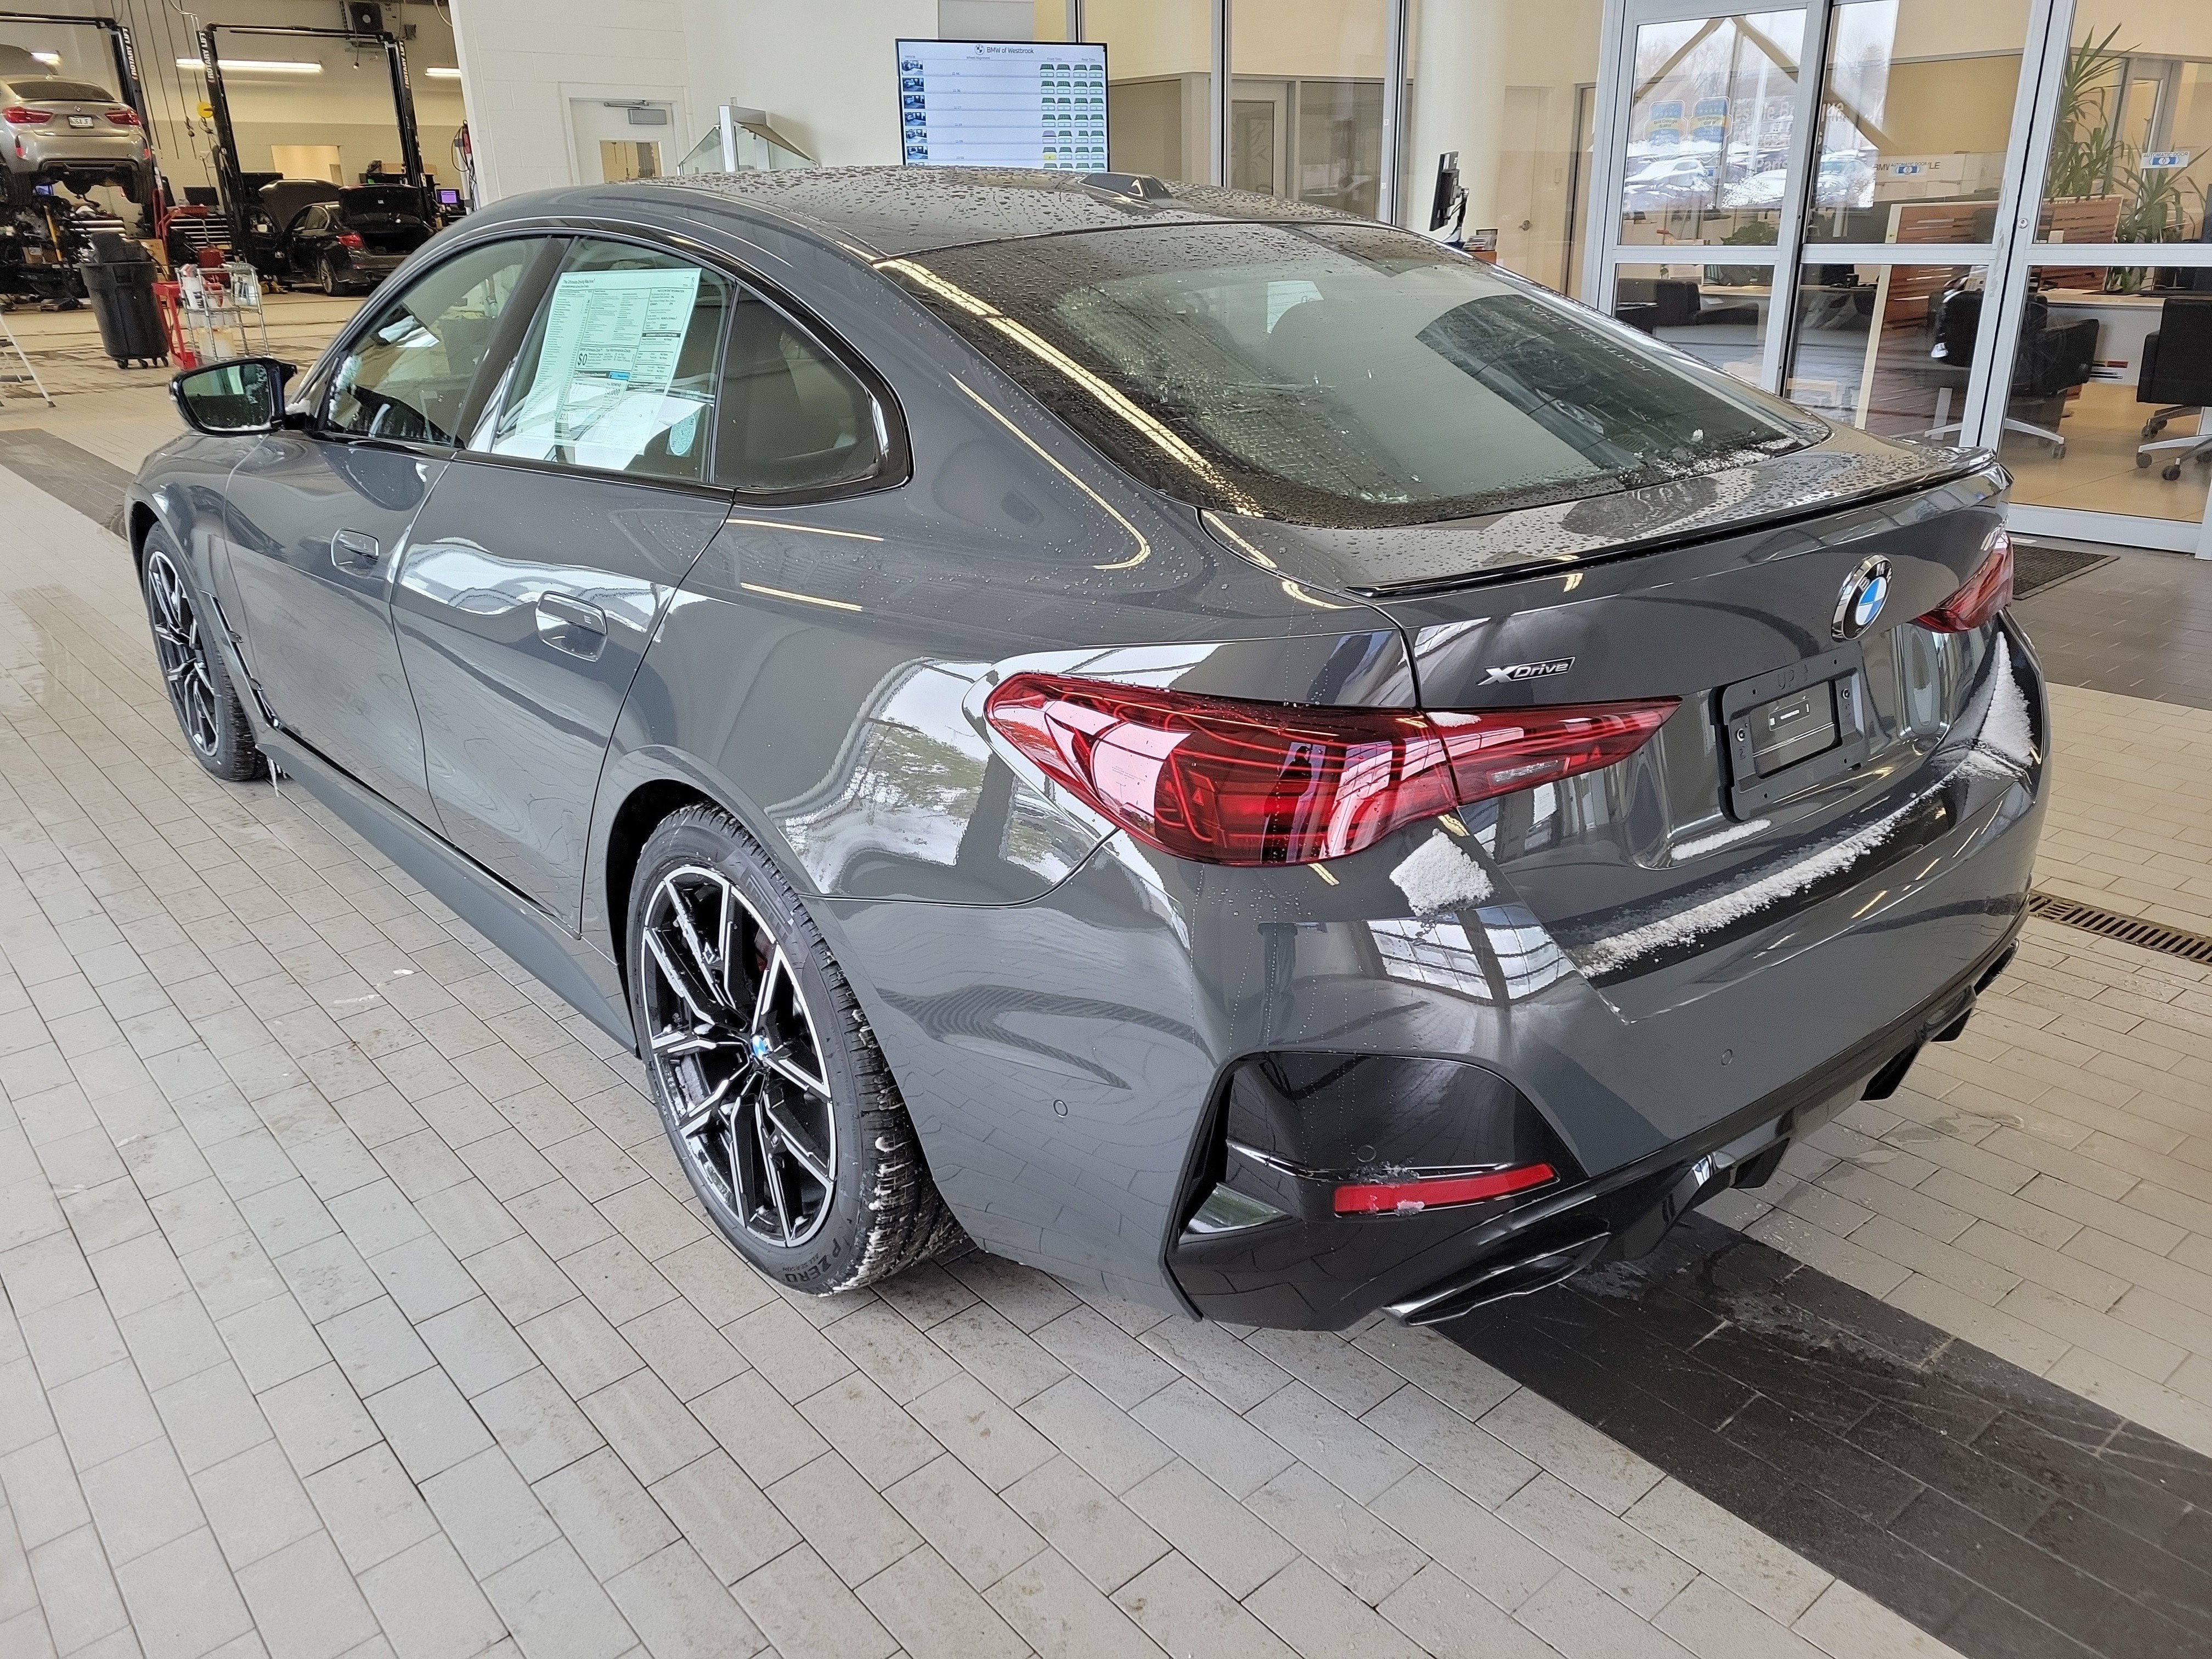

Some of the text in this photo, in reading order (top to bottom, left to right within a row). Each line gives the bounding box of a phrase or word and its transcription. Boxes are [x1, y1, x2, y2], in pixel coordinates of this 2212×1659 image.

[122, 27, 138, 76] ROTARY LIFT
[199, 32, 215, 78] ROTARY LIFT
[402, 57, 410, 86] ROTARY
[577, 352, 588, 366] $0
[1858, 561, 1893, 592] BMW
[785, 1238, 841, 1282] P ZERO
